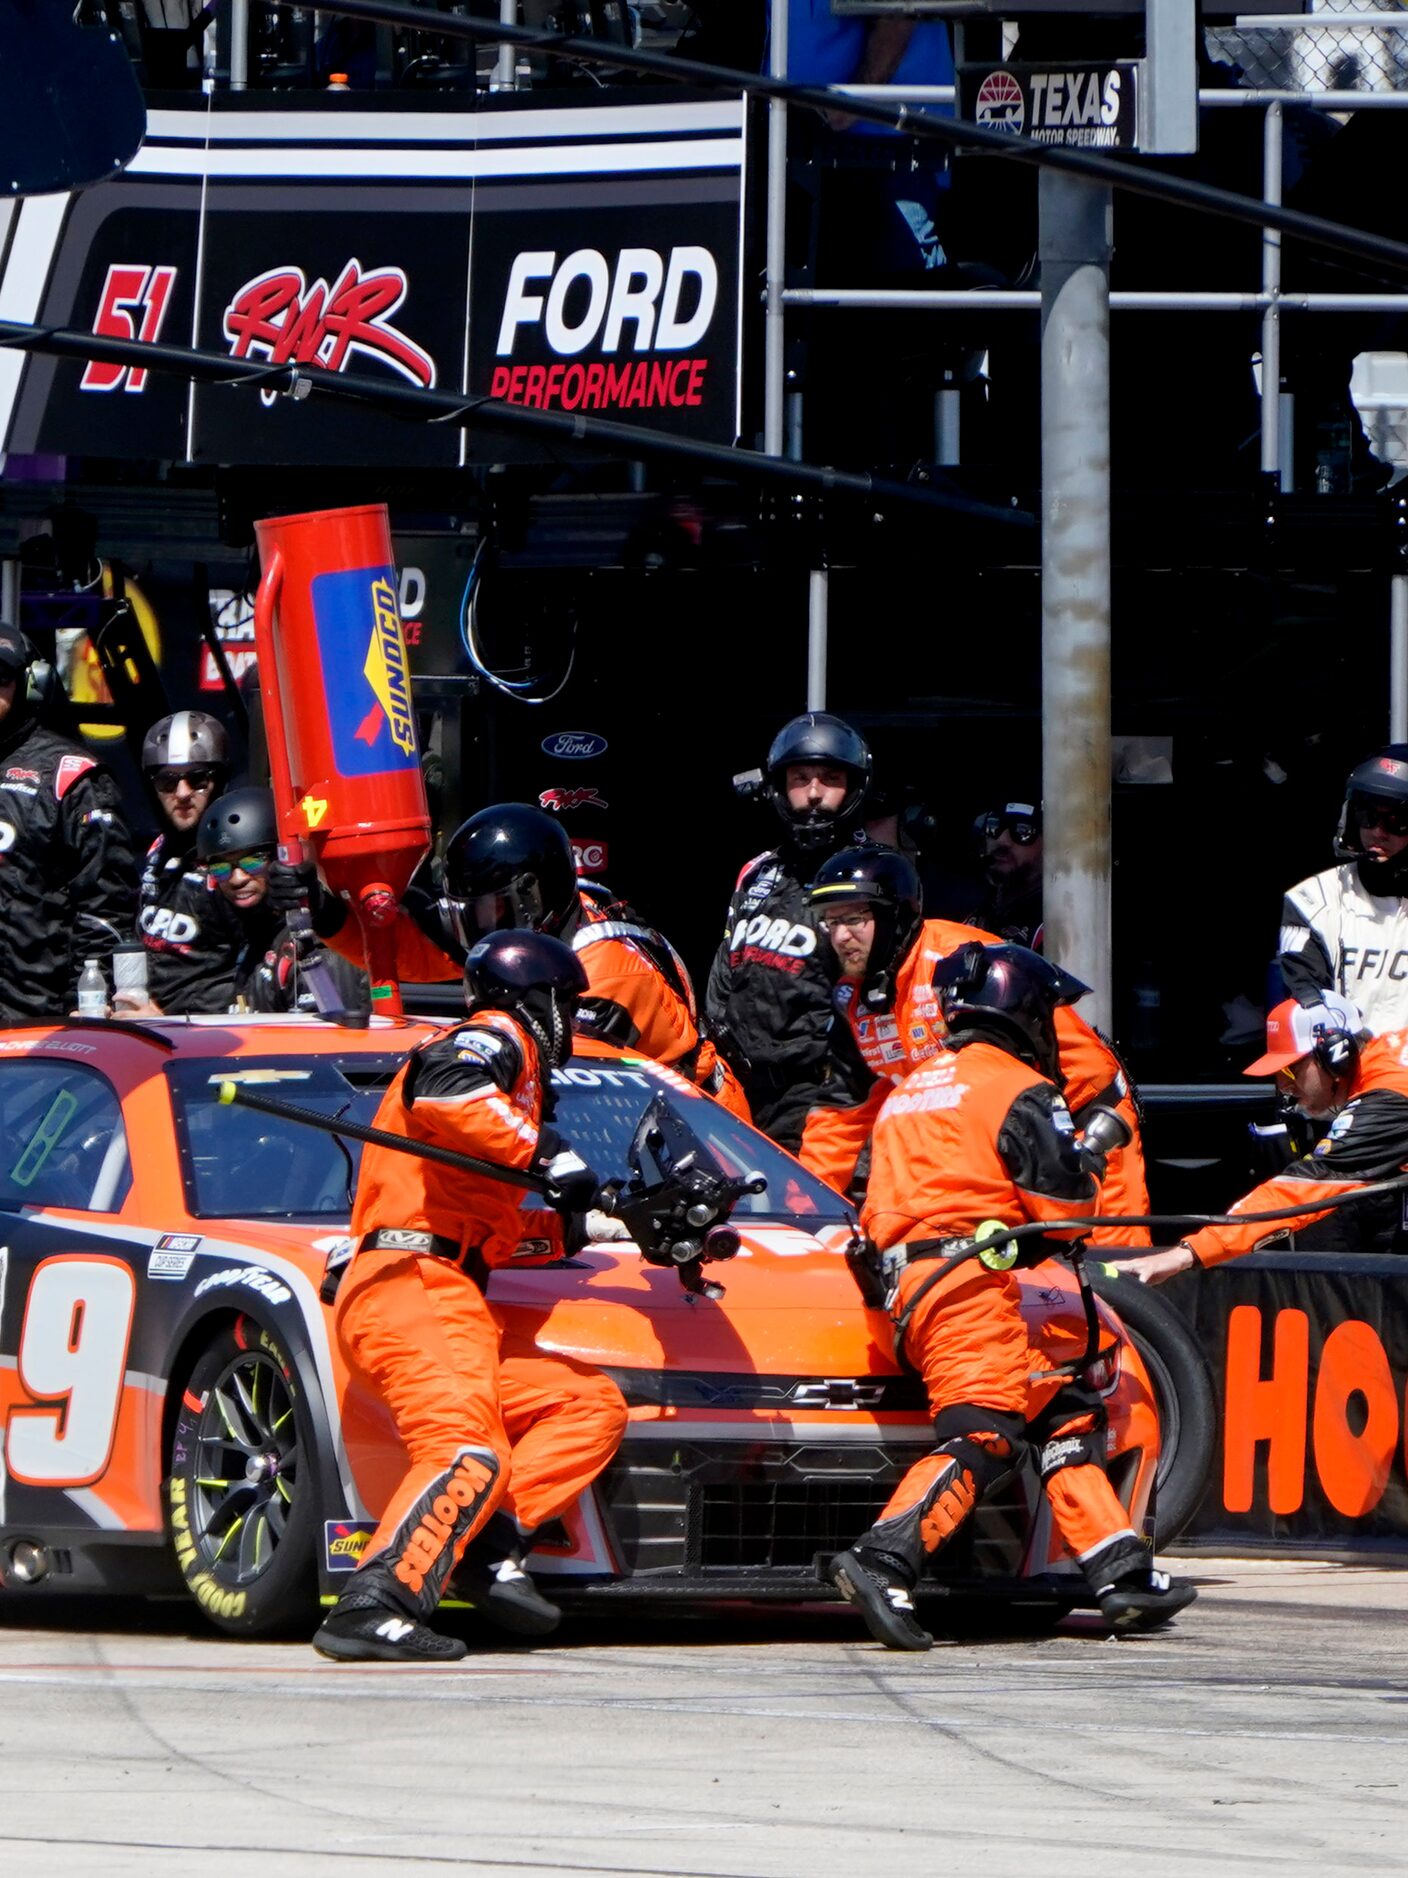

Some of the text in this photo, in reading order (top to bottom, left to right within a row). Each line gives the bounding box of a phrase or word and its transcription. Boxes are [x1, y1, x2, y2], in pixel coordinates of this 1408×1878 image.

[1030, 70, 1121, 126] TEXAS
[1031, 127, 1121, 147] MOTOR SPEEDWAY
[79, 264, 177, 392] 51
[223, 257, 437, 405] RWR
[495, 246, 719, 356] FORD
[490, 360, 708, 410] PERFORMANCE
[375, 591, 414, 746] SUNOCO
[730, 914, 817, 957] FORD
[194, 1266, 292, 1305] GOODYEAR
[4, 1253, 138, 1488] 9
[335, 1540, 369, 1554] SUN
[395, 1455, 493, 1593] HOOTERS
